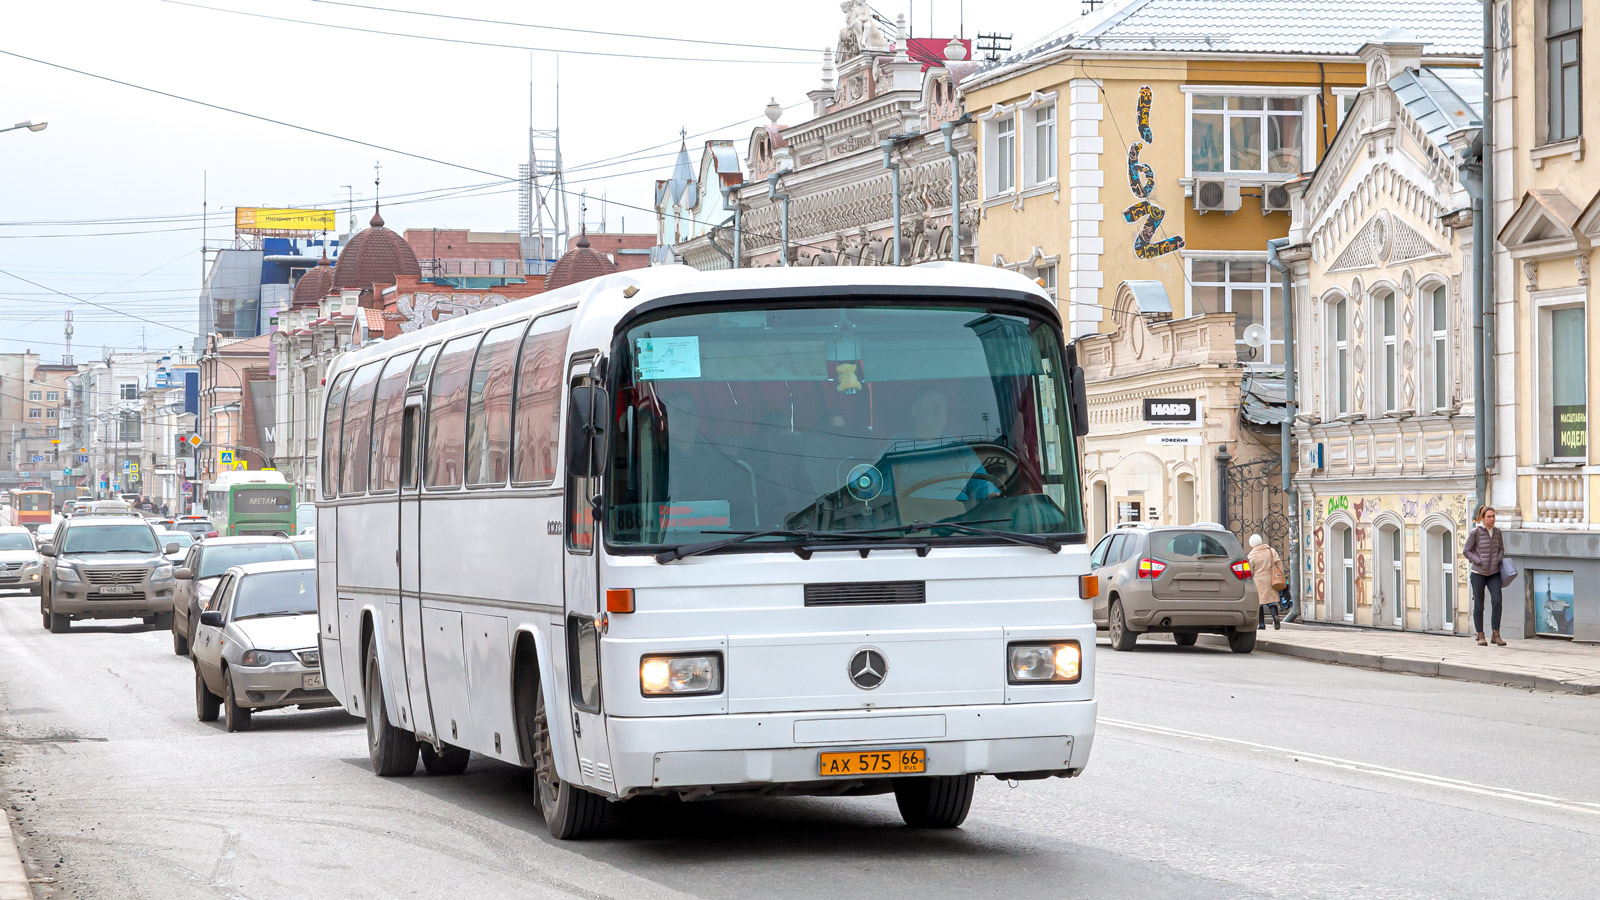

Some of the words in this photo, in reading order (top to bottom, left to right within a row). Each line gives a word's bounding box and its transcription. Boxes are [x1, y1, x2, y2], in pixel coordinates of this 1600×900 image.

[1151, 403, 1191, 416] HARD
[249, 497, 277, 505] МЕТАН
[859, 753, 891, 771] 575
[901, 752, 918, 765] 66
